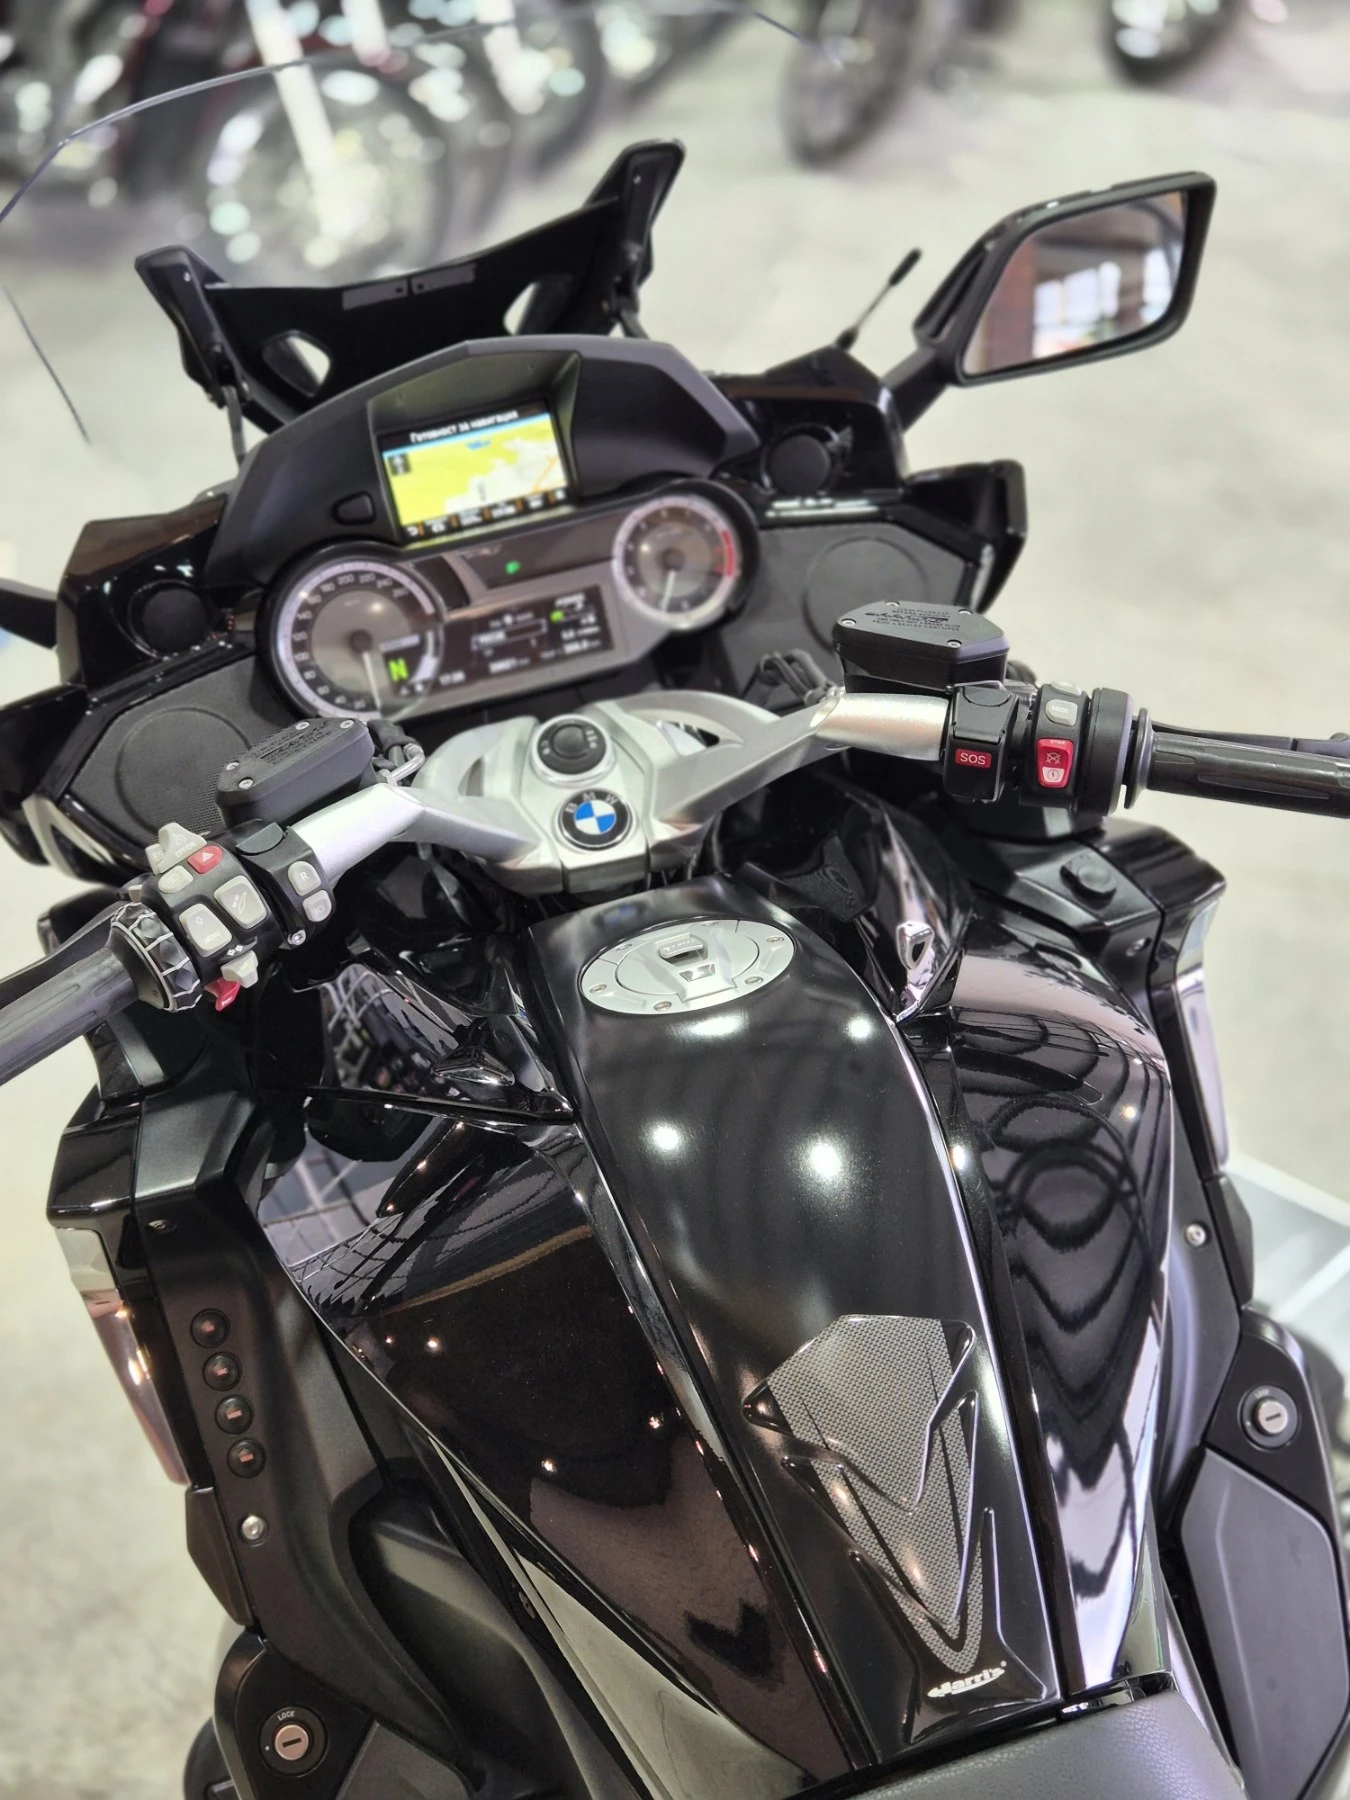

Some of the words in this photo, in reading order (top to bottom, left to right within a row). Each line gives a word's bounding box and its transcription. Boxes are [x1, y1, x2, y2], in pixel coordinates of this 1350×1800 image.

[388, 657, 409, 682] N
[960, 752, 986, 766] SOS
[564, 791, 619, 814] BMW
[300, 871, 309, 881] R
[277, 1710, 296, 1721] LOCK
